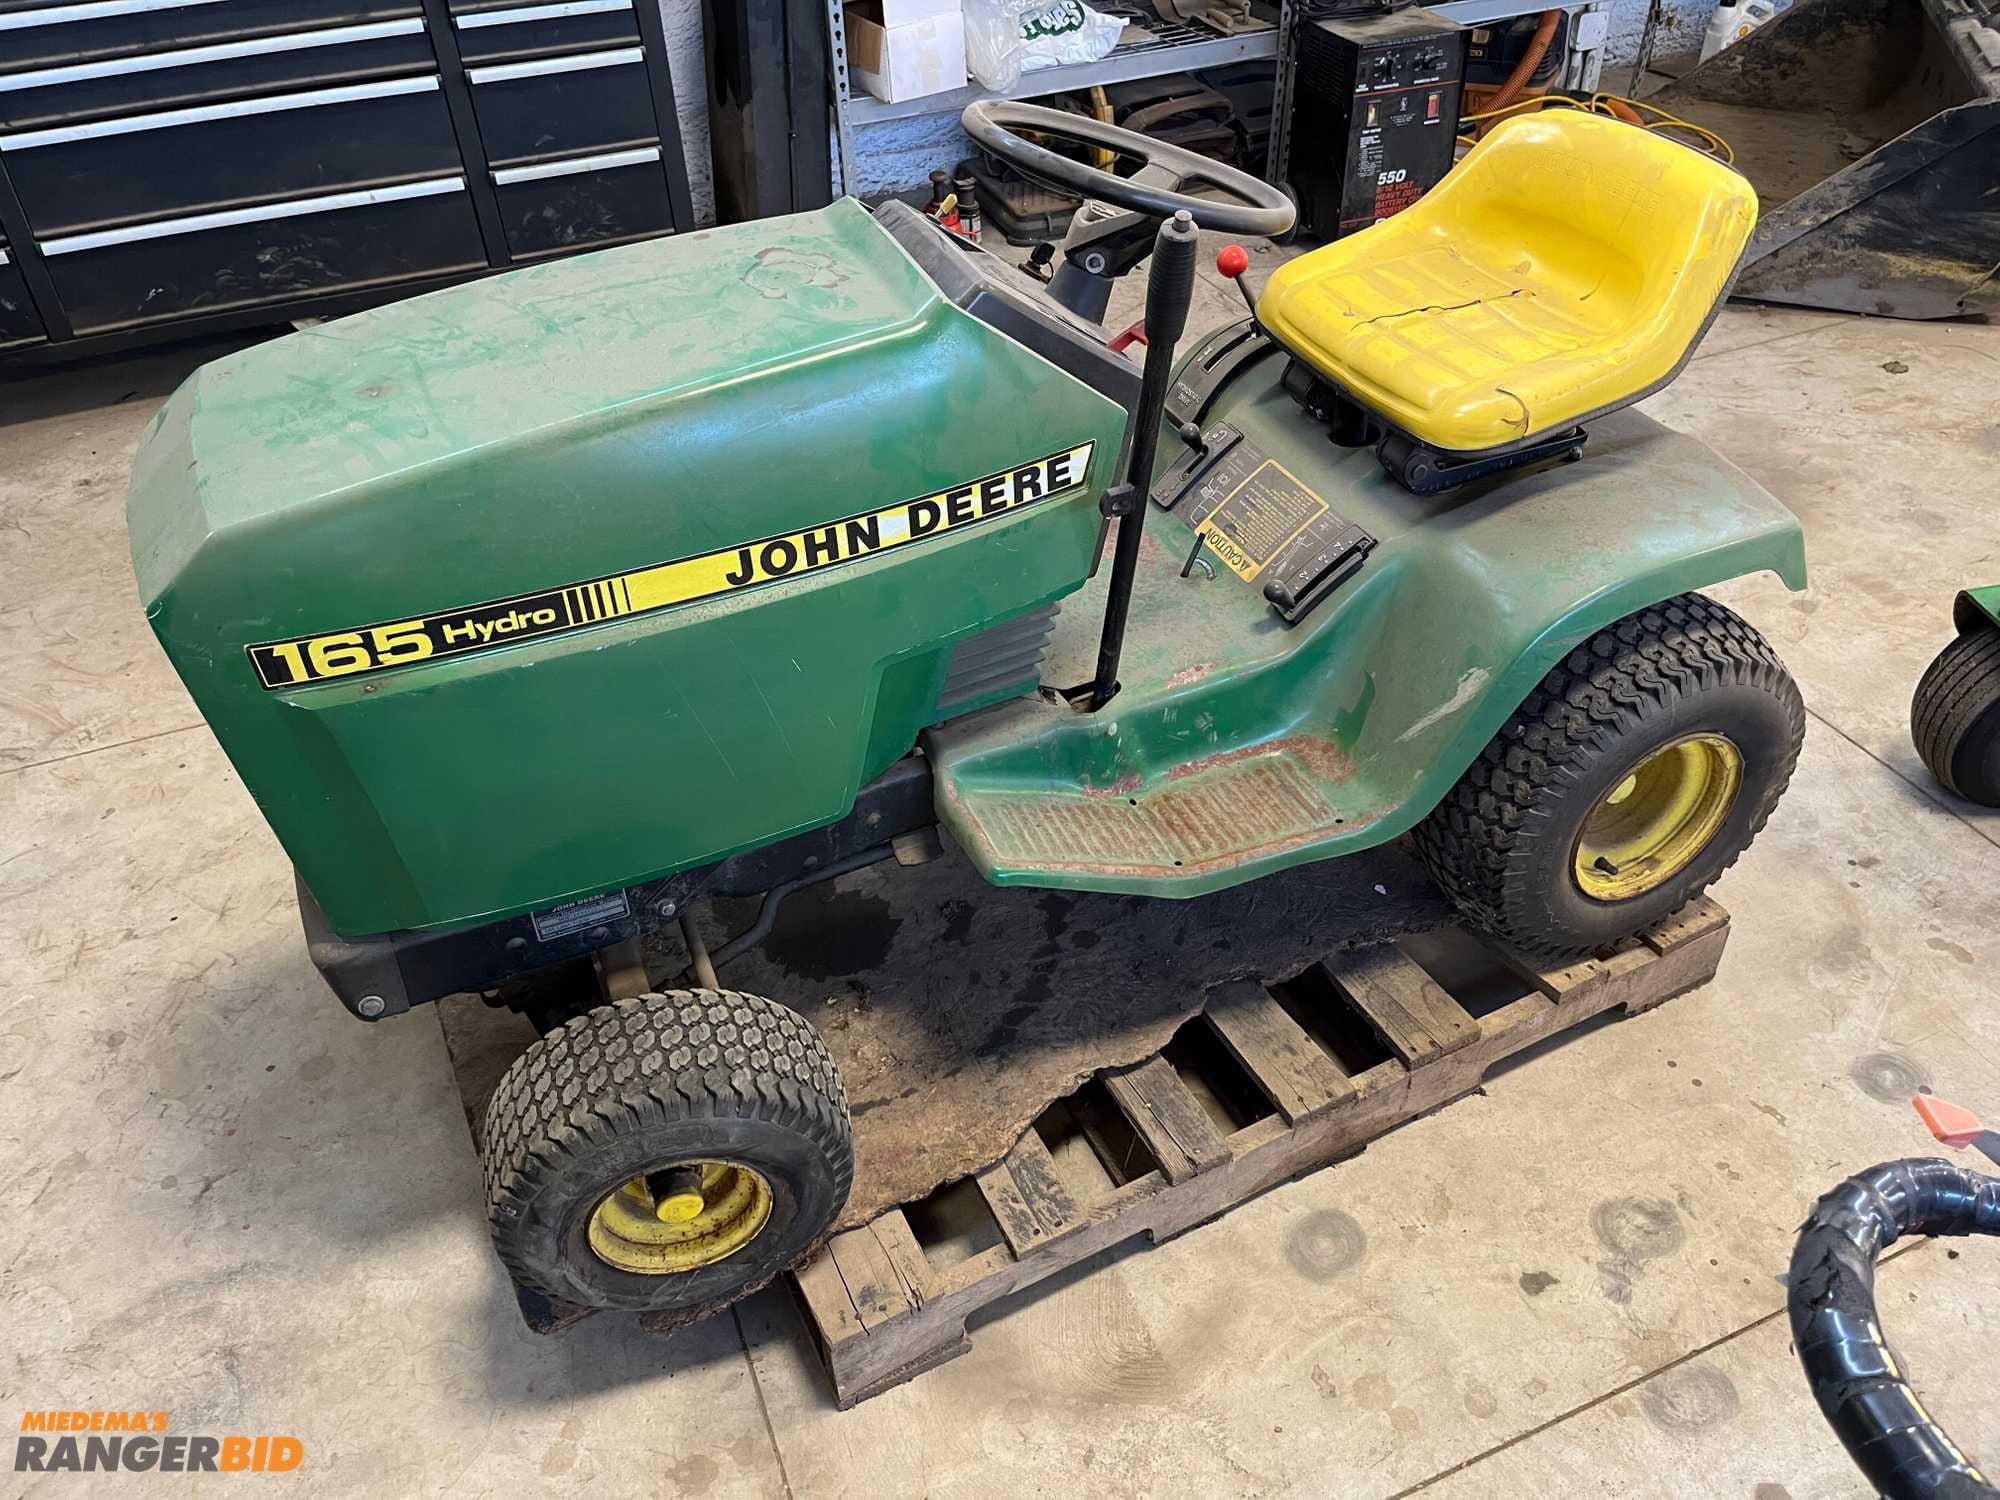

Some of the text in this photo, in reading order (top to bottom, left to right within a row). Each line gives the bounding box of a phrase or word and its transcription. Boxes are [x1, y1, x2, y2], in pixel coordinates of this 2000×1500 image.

[1377, 169, 1407, 186] 550
[726, 453, 1072, 586] JOHN DEERE
[1204, 527, 1245, 568] CAUTION
[272, 607, 556, 682] 165 Hydro
